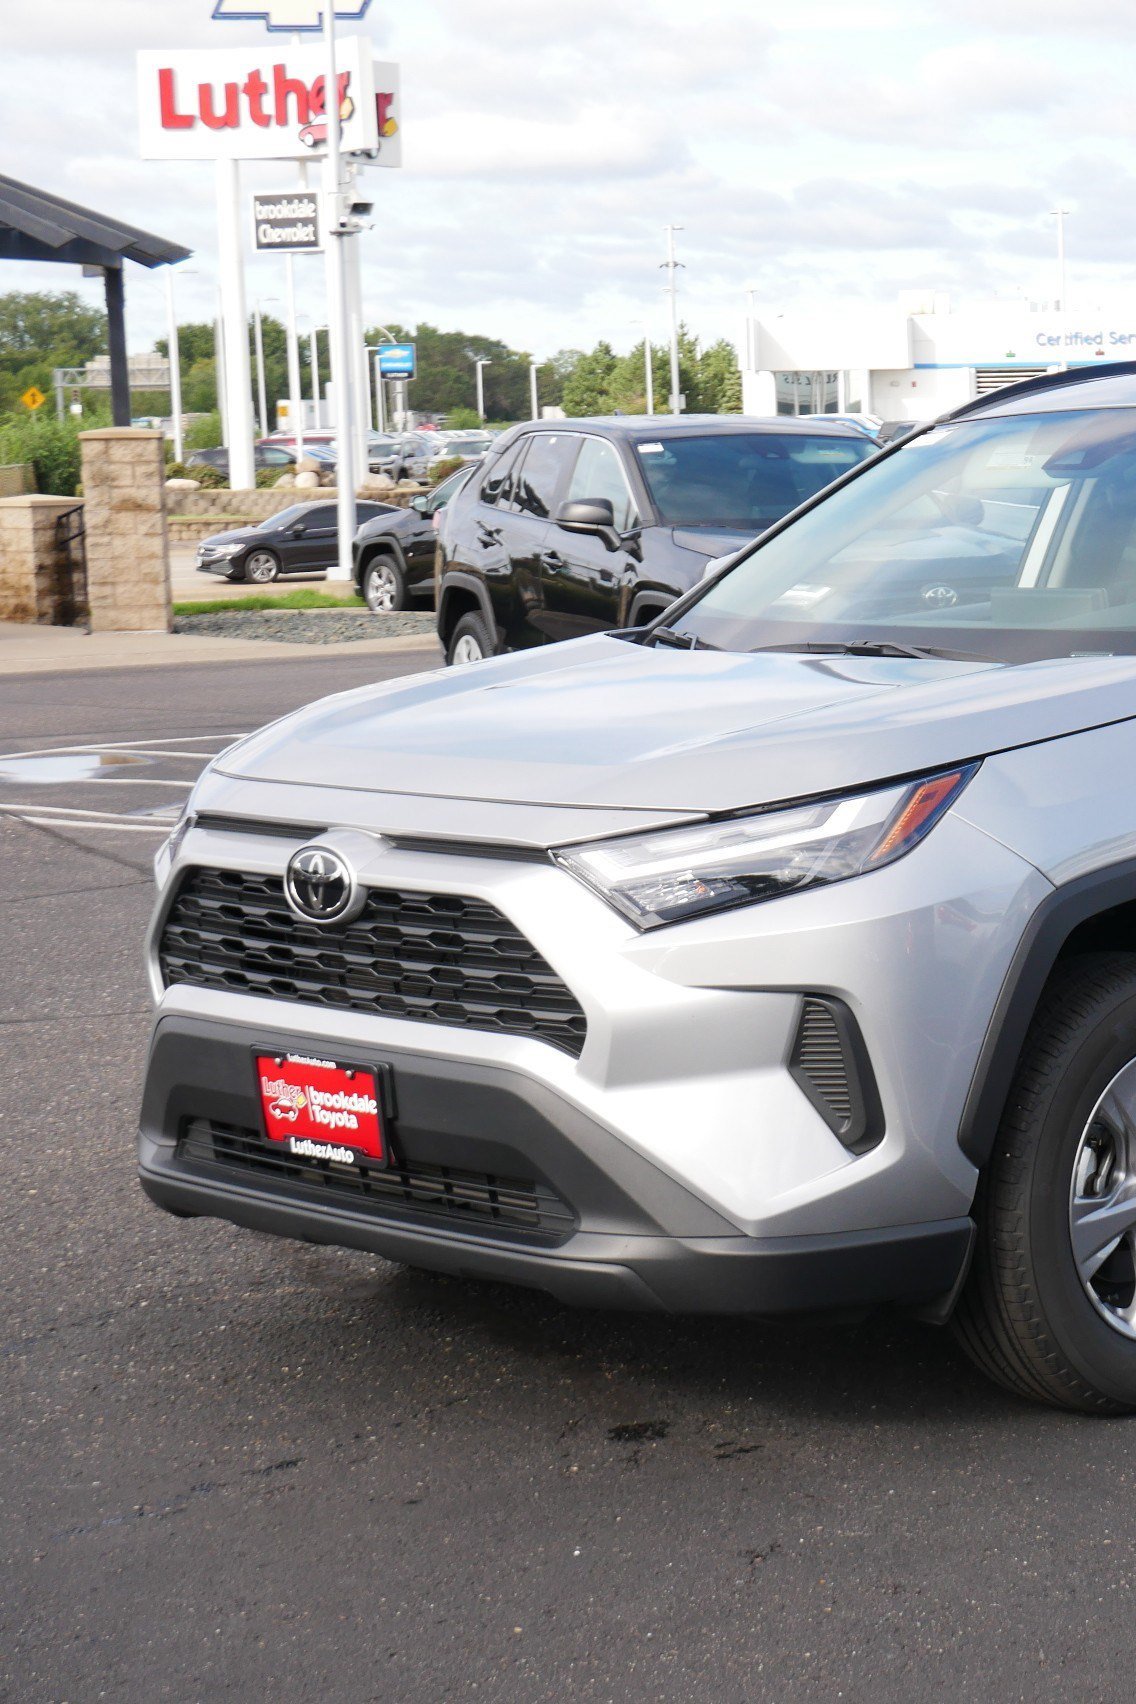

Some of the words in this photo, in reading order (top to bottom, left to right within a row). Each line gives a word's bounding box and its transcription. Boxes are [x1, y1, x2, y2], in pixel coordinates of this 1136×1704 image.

[158, 64, 351, 129] Luther
[258, 222, 316, 244] Chevrolet
[1036, 331, 1104, 347] Certified
[311, 1086, 378, 1114] brookdale
[312, 1105, 359, 1129] Toyota
[289, 1136, 355, 1164] LutherAuto
